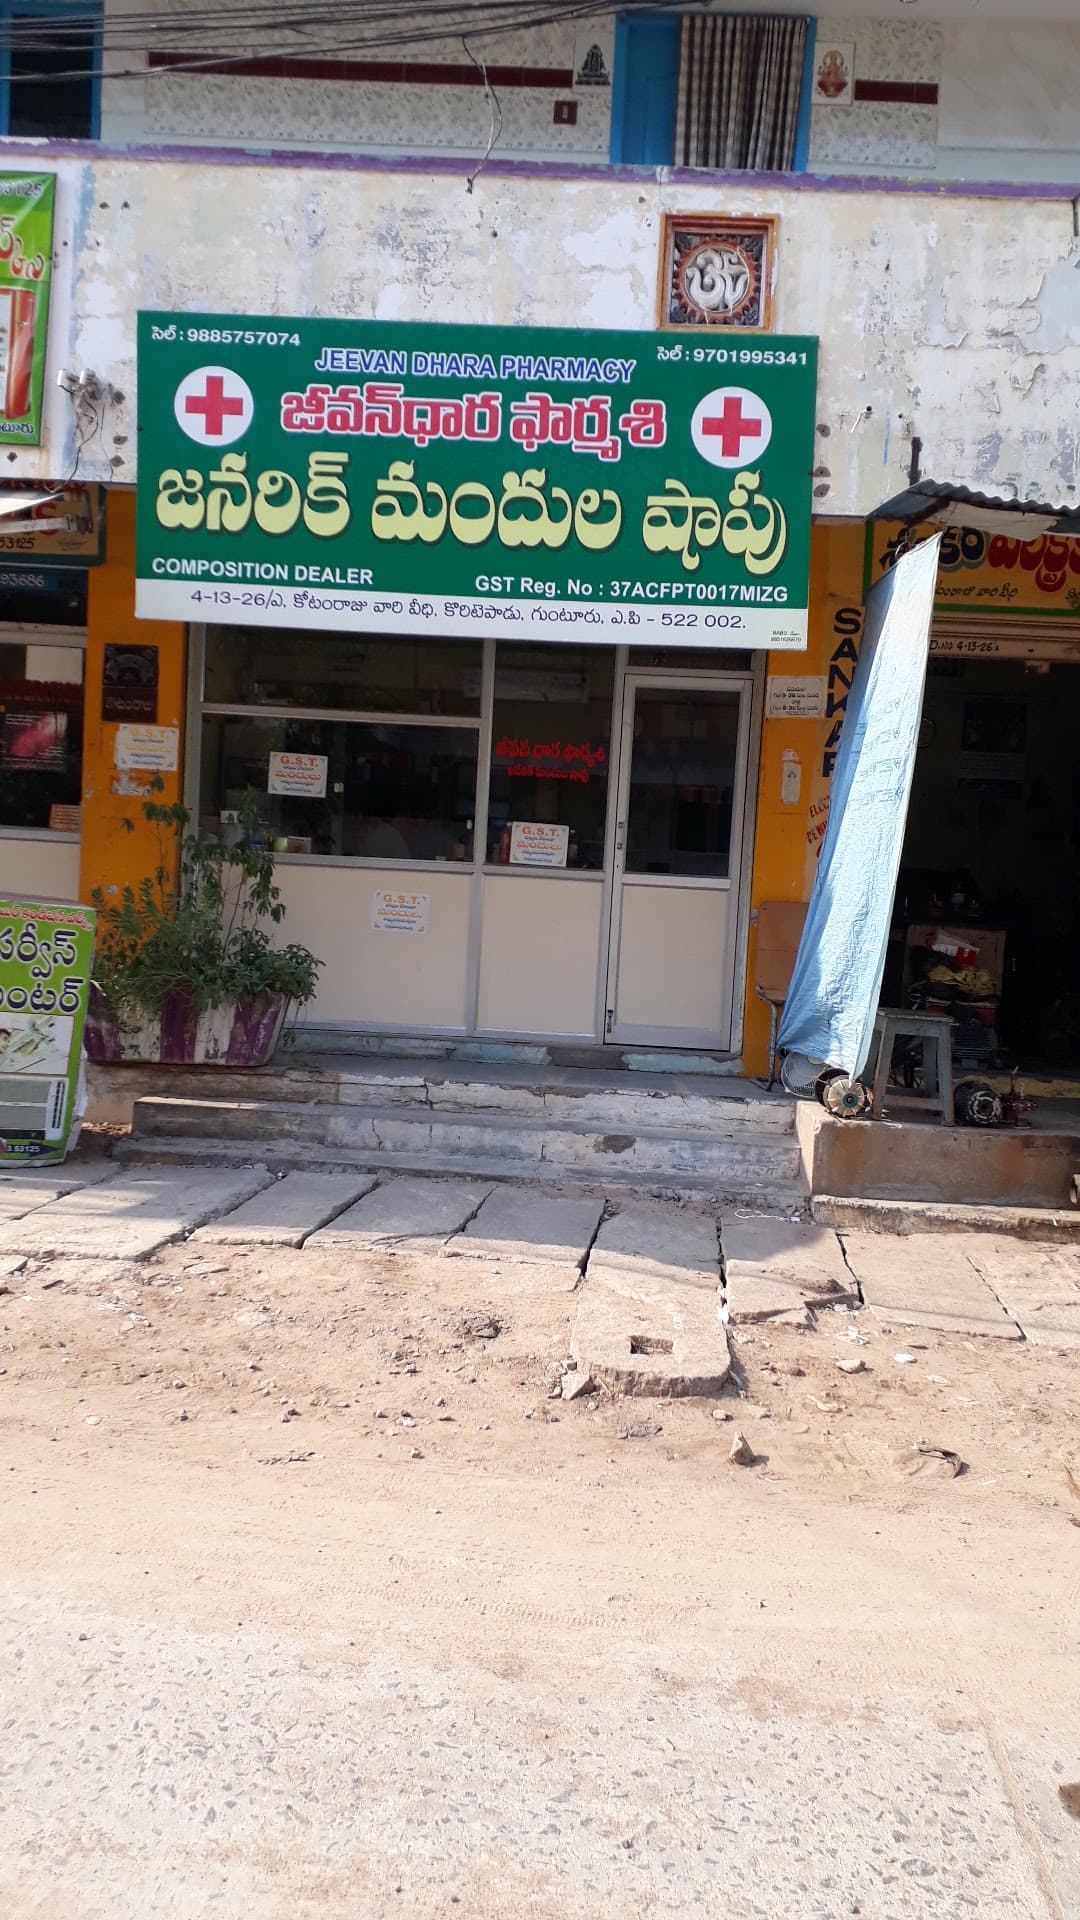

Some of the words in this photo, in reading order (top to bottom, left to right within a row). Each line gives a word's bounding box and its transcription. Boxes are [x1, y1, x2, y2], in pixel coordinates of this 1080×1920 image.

[187, 328, 301, 347] 9885757074
[315, 348, 406, 374] JEEVAN
[412, 352, 497, 380] DHARA
[501, 355, 637, 383] PHARMACY
[693, 348, 807, 366] 9701995341
[156, 451, 350, 537] జనరిక్
[371, 459, 622, 550] మందుల
[643, 470, 787, 575] షాపు
[152, 557, 289, 580] COMPOSITION
[294, 565, 374, 585] DEALER
[475, 576, 515, 593] GST
[520, 578, 561, 597] Reg.
[567, 579, 593, 596] No
[610, 581, 788, 602] 37ACFPT0017MIZG
[293, 591, 368, 613] కోటంరాజు
[373, 600, 404, 615] వారి
[661, 613, 698, 628] 522
[0, 978, 84, 1012] ంటర్
